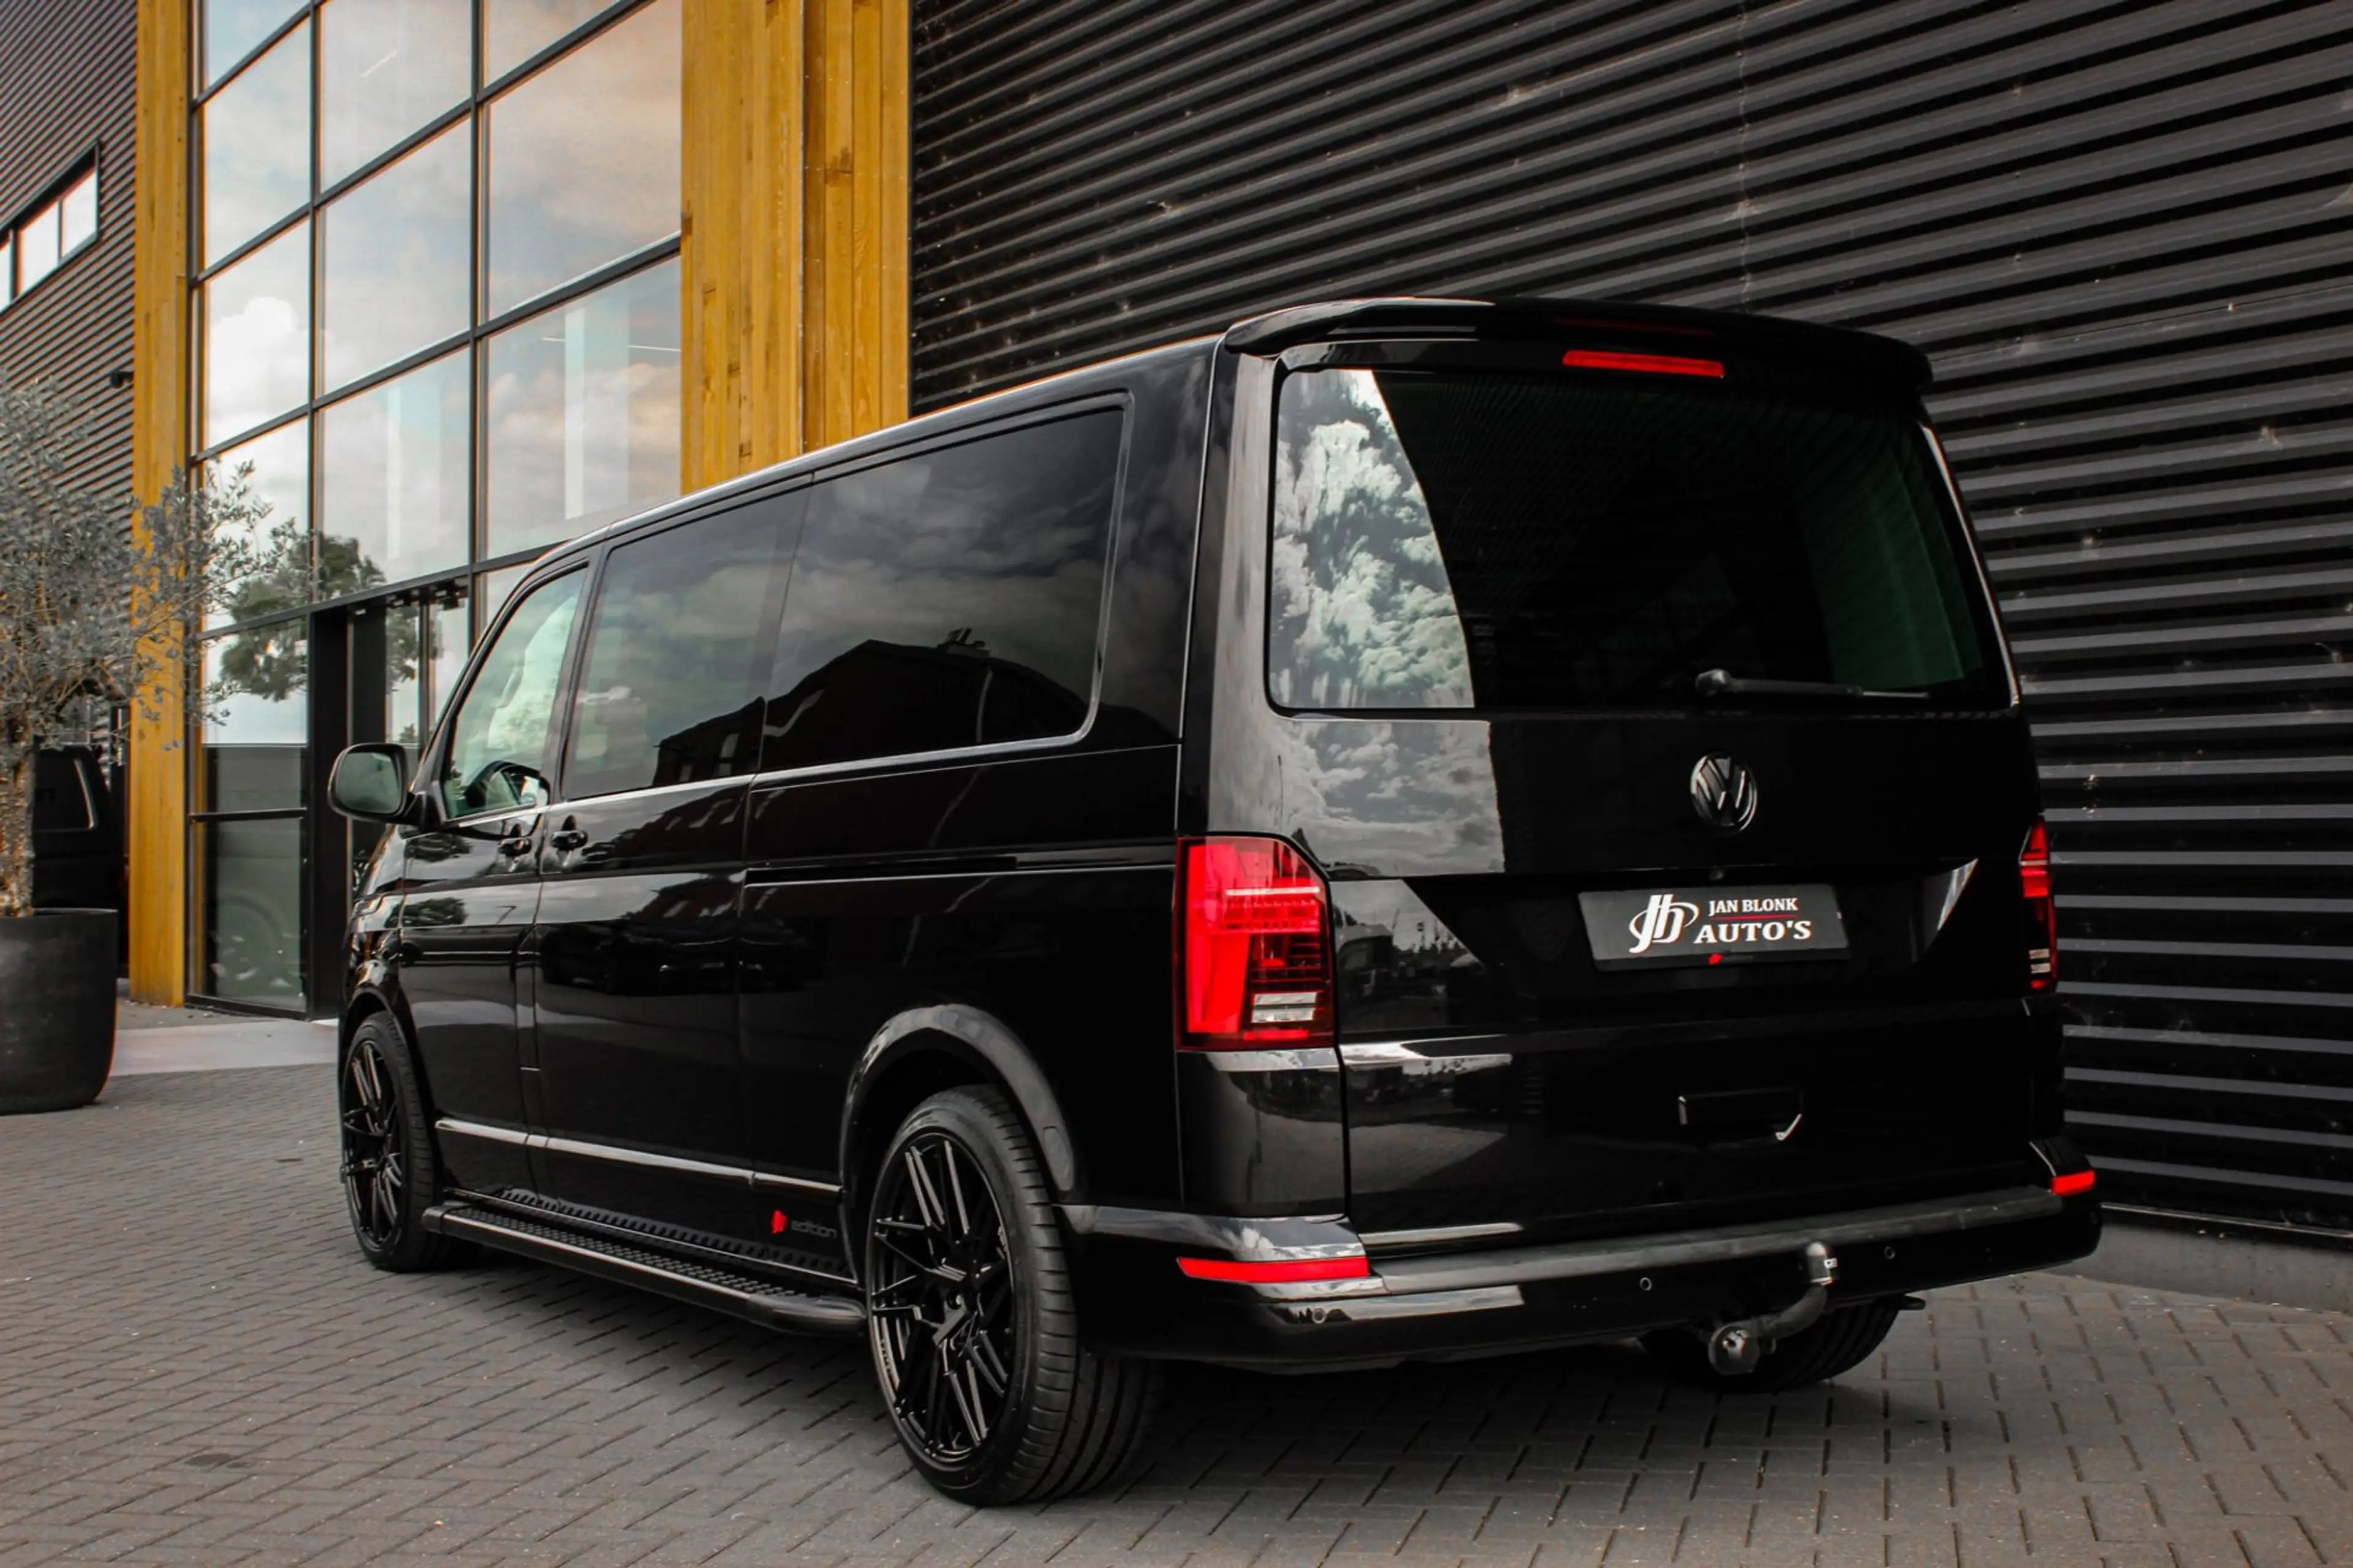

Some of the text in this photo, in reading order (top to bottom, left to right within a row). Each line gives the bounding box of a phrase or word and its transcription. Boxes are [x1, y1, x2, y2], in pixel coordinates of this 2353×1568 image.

[1708, 898, 1798, 917] JAN BLONK
[1694, 920, 1812, 944] AUTO'S
